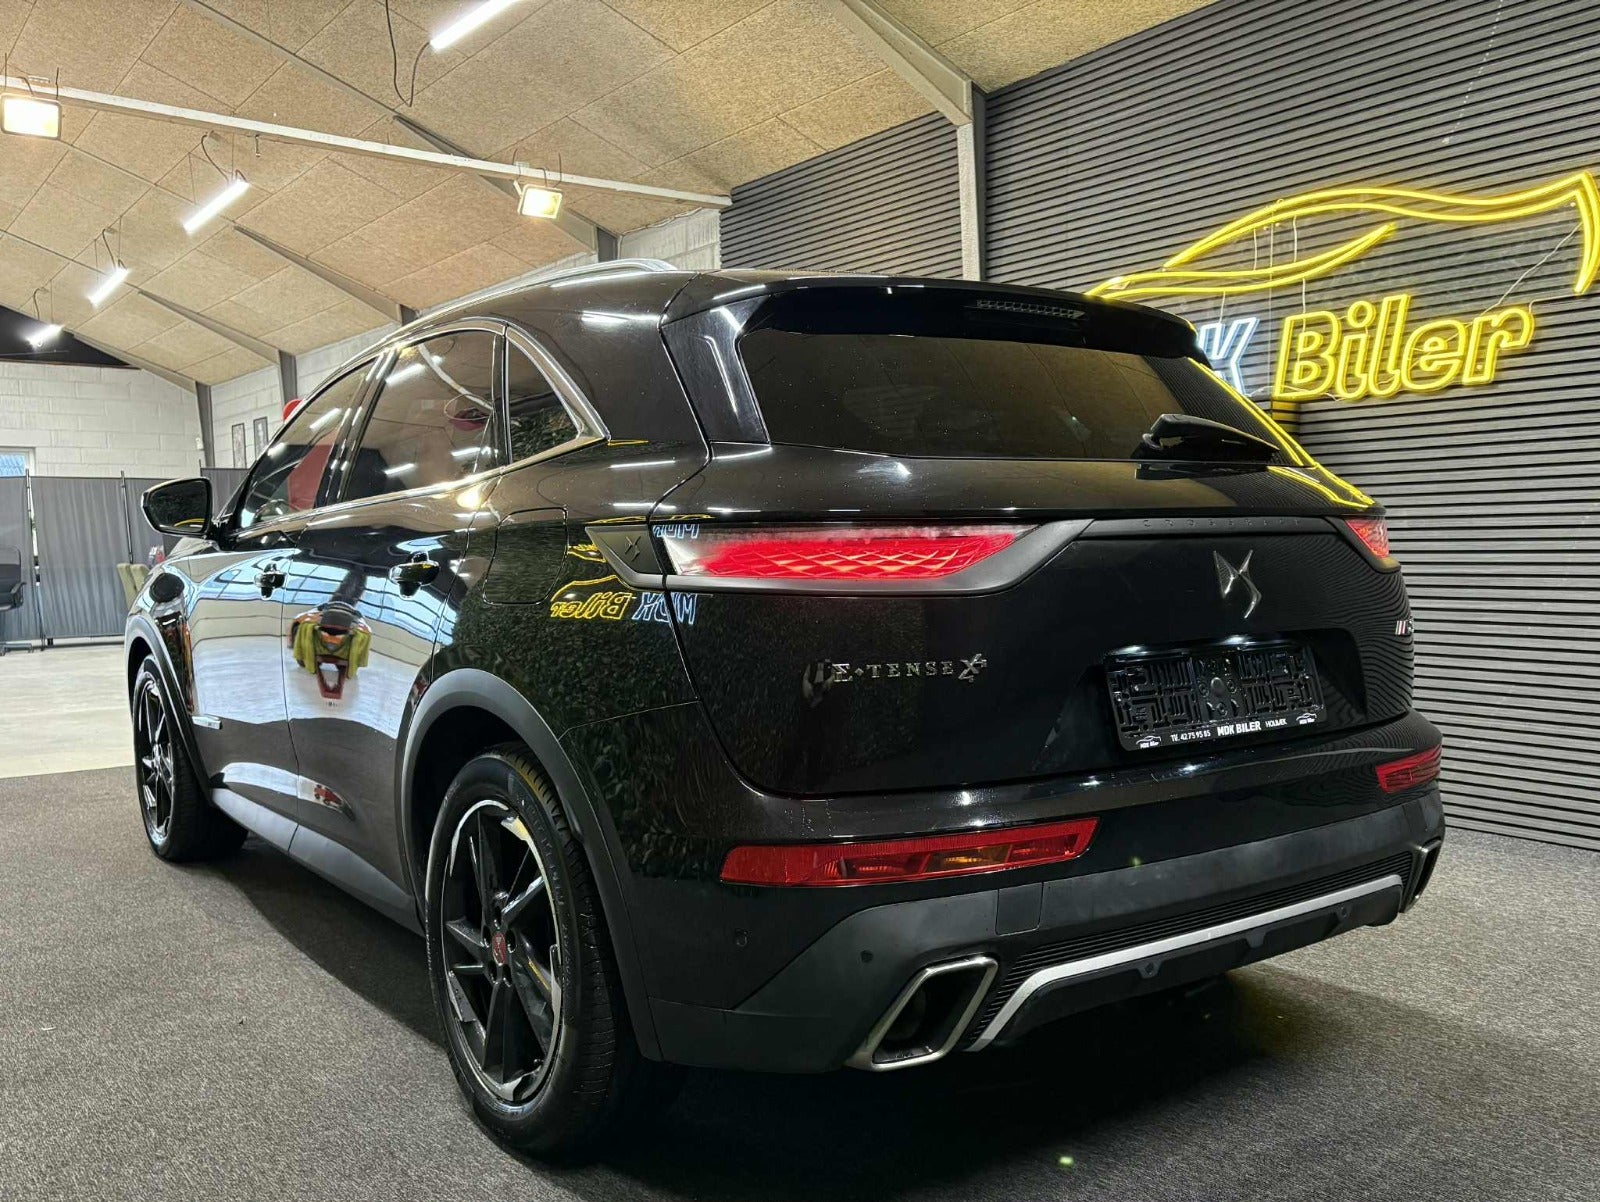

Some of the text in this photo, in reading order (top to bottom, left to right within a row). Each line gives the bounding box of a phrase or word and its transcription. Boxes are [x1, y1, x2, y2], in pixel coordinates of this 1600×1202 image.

[1272, 294, 1533, 399] Biler
[1217, 723, 1235, 737] MDK
[1236, 721, 1262, 734] BILER
